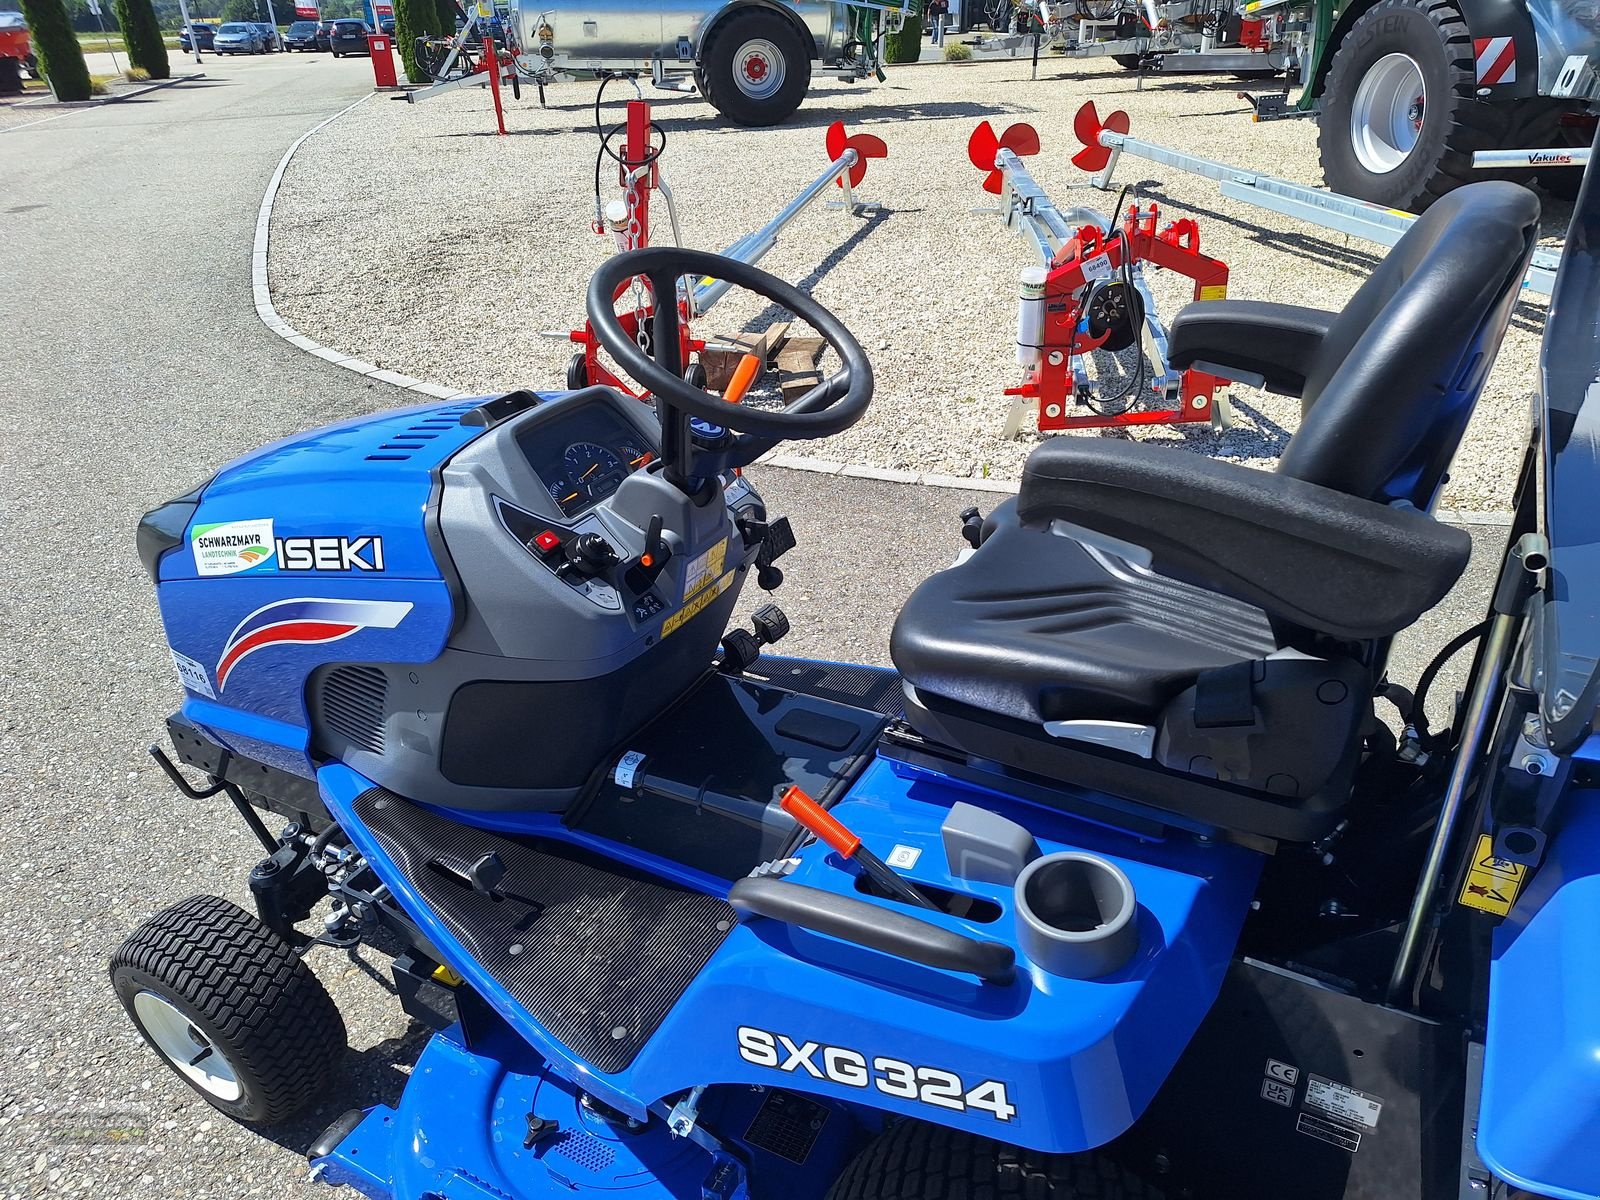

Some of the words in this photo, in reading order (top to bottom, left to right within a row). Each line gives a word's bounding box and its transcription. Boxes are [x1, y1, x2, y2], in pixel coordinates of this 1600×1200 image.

[1528, 152, 1572, 163] Vakutec
[1088, 259, 1108, 273] 68490
[198, 534, 261, 548] SCHWARZMAYR
[201, 550, 238, 559] LANDTECHNIK
[275, 537, 384, 571] ISEKI
[176, 662, 206, 684] 68116
[1270, 1064, 1295, 1081] CE
[1268, 1083, 1289, 1094] UK
[1266, 1090, 1288, 1103] CA
